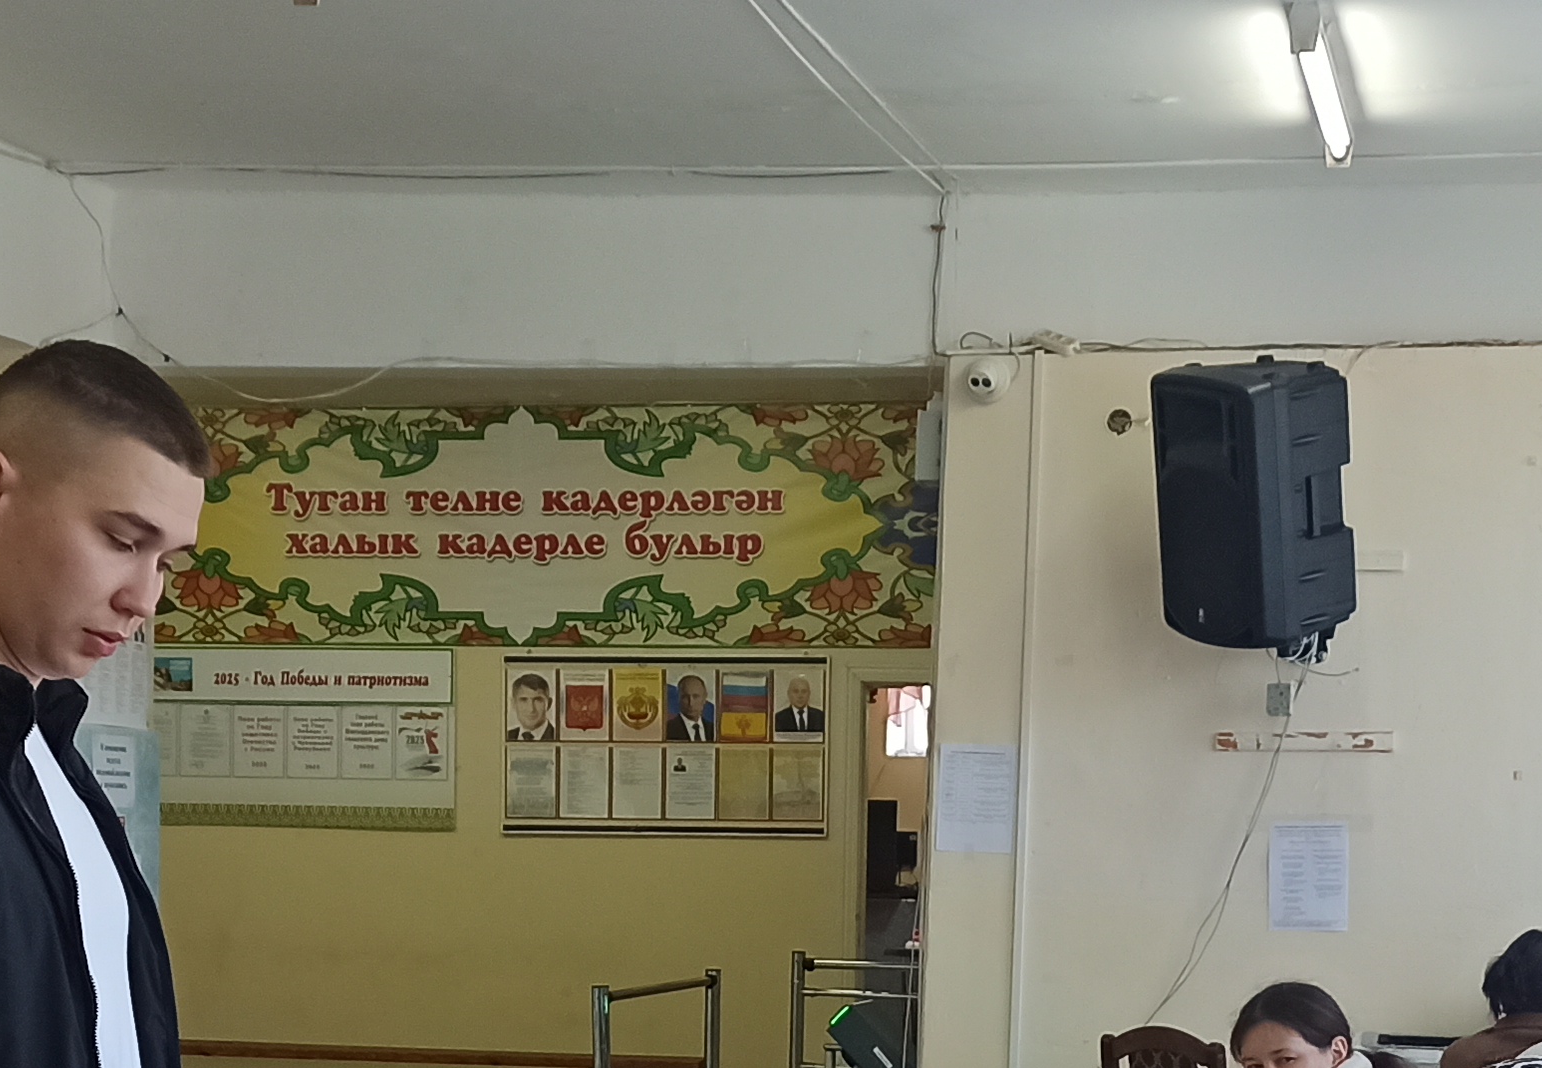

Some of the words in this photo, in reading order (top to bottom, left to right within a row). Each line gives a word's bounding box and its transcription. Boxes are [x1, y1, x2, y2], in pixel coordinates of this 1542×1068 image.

[265, 482, 388, 519] Туган
[405, 489, 523, 514] телне
[541, 488, 785, 519] кадерләгән
[284, 531, 420, 556] халык
[436, 531, 607, 563] кадерле
[624, 519, 763, 563] булыр
[213, 672, 240, 686] 2025
[253, 670, 276, 687] Год
[280, 668, 328, 687] Победы
[333, 674, 343, 686] и
[347, 674, 430, 690] патриотизма
[405, 734, 426, 745] 2025
